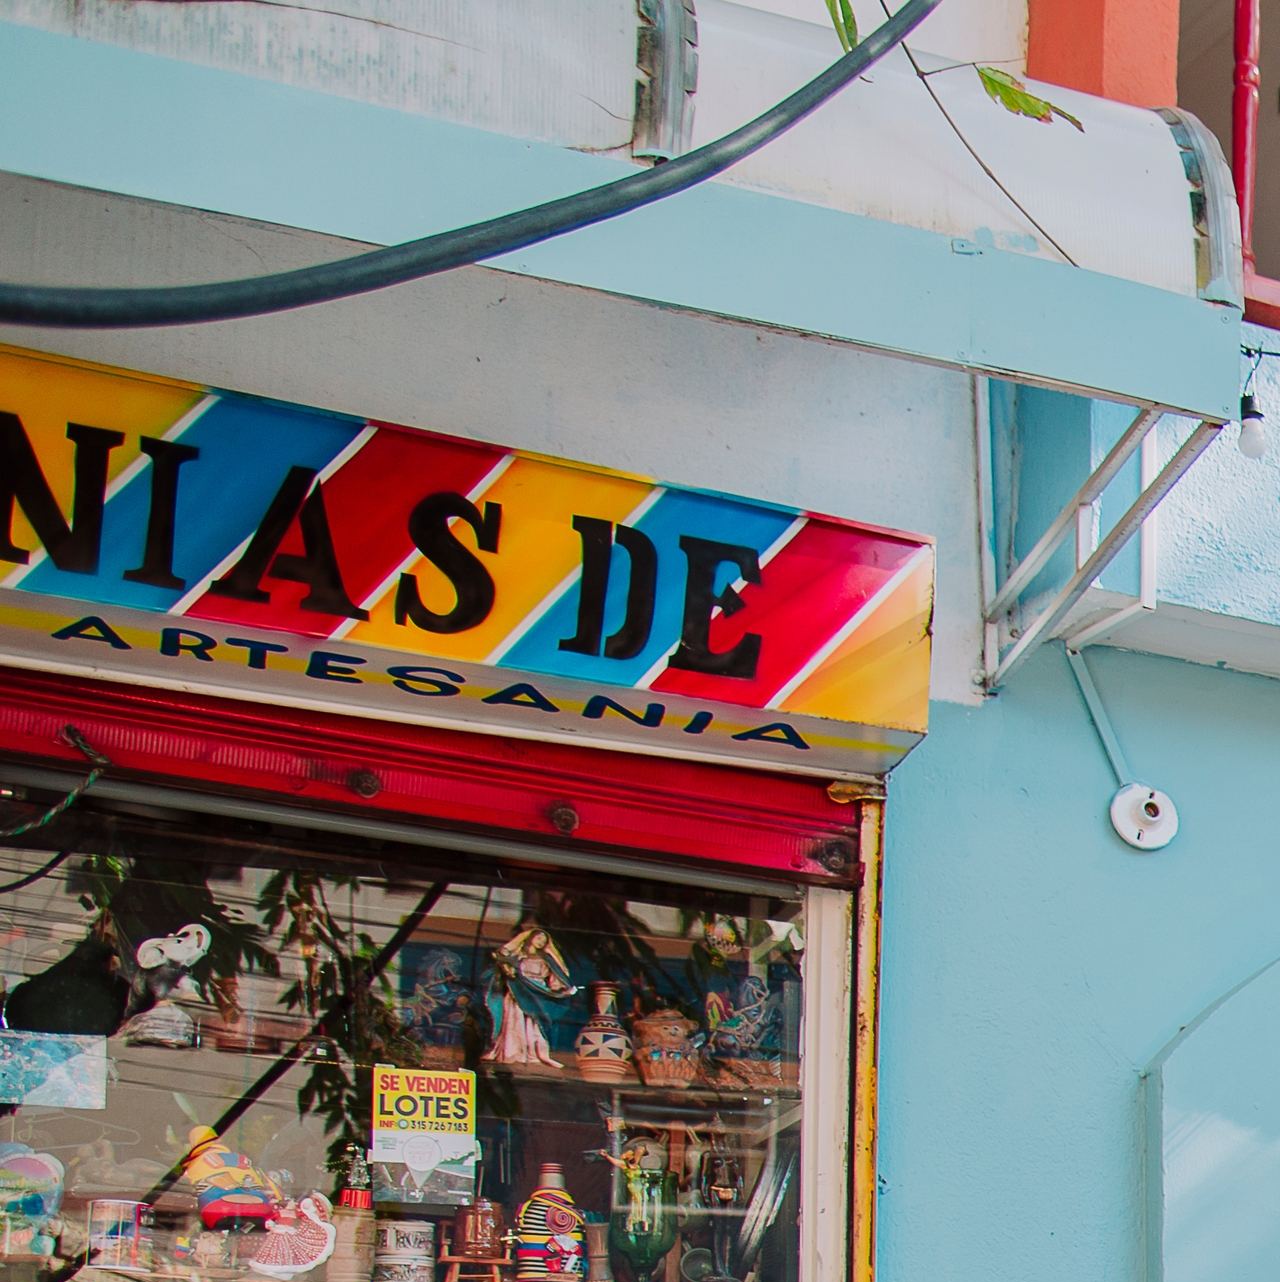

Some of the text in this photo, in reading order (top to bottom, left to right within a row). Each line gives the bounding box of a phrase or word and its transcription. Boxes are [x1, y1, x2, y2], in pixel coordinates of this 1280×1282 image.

[559, 514, 763, 680] DE
[51, 615, 811, 750] ARTESANIA
[380, 1074, 470, 1095] SE VENDEN
[379, 1094, 468, 1119] LOTES
[411, 1120, 427, 1129] 315
[428, 1121, 446, 1131] 726
[447, 1122, 468, 1132] 7183
